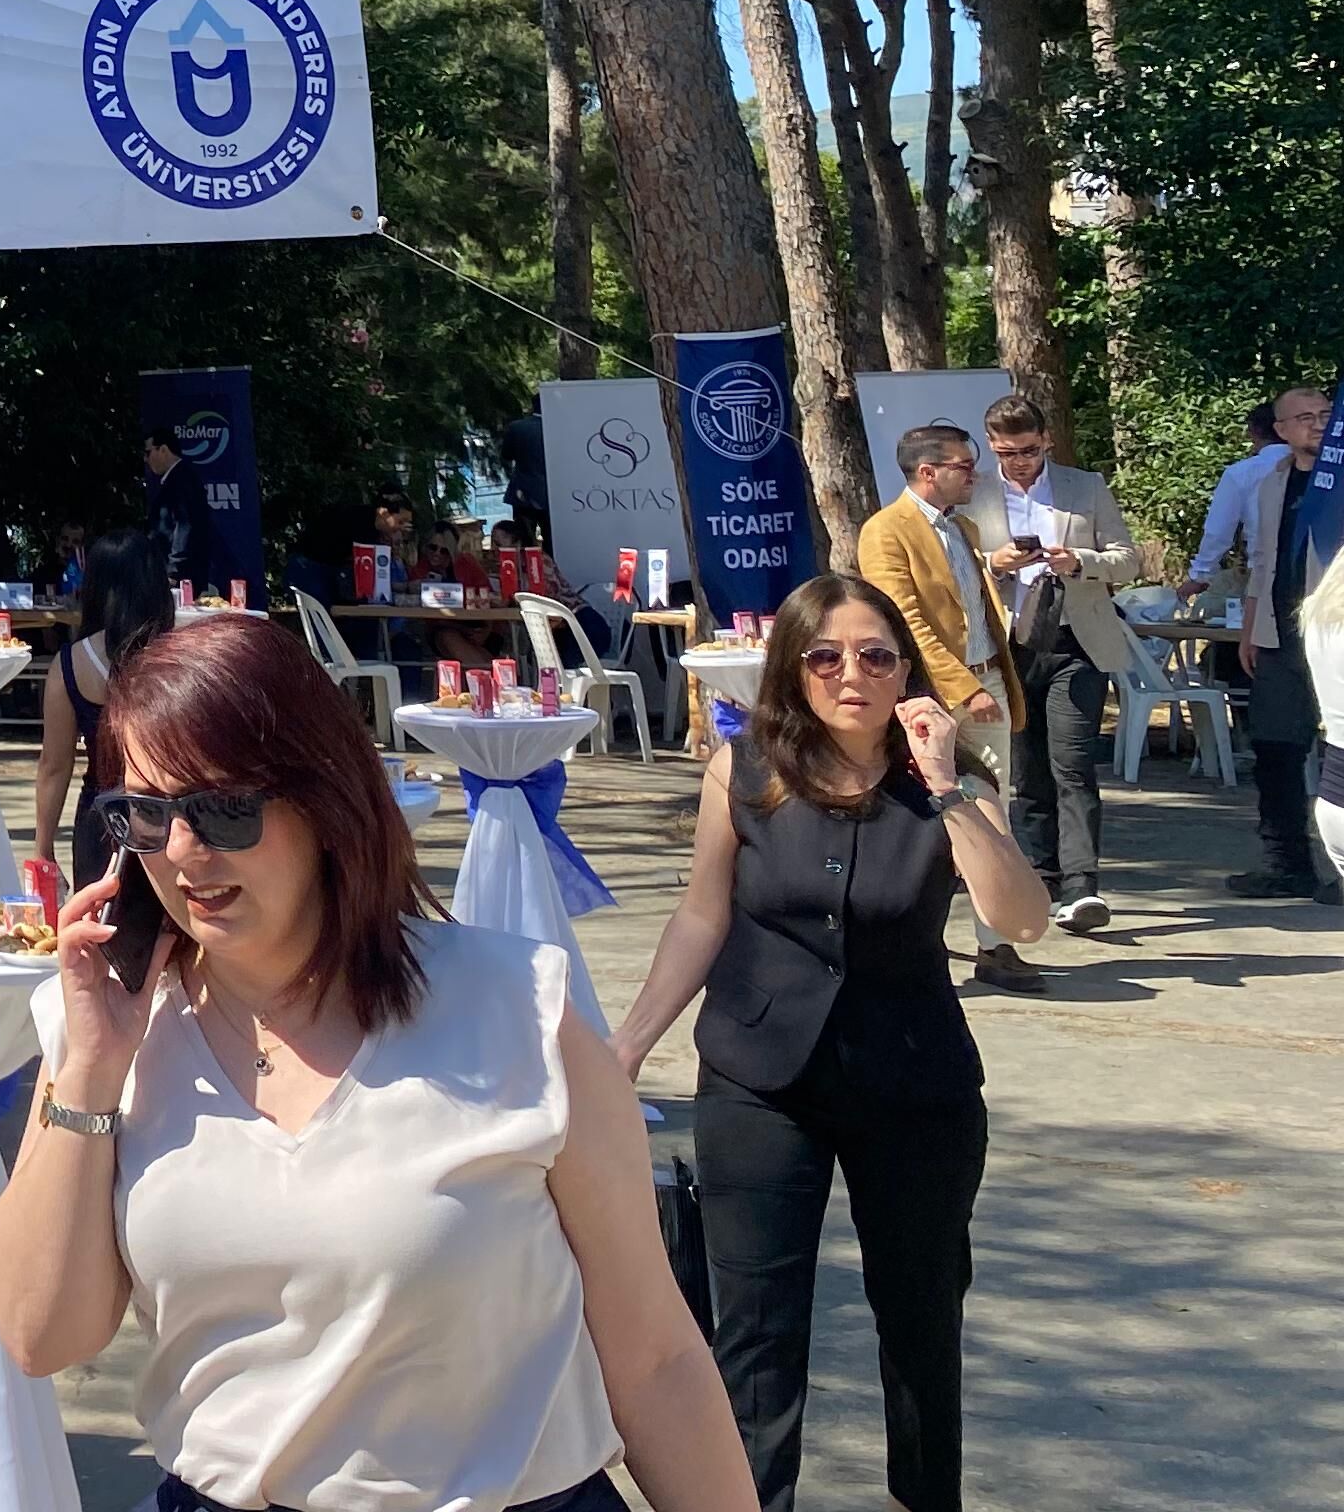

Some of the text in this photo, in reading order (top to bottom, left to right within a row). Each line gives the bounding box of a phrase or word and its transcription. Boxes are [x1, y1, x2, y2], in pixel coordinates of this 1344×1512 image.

[93, 19, 126, 120] AYDIN
[121, 127, 316, 200] ÜNİVERSİTESİ
[200, 144, 238, 157] 1992
[174, 425, 222, 439] BioMar
[571, 485, 676, 514] SÖKTAŞ
[721, 477, 779, 503] SÖKE
[706, 510, 794, 536] TİCARET
[723, 545, 788, 569] ODASI
